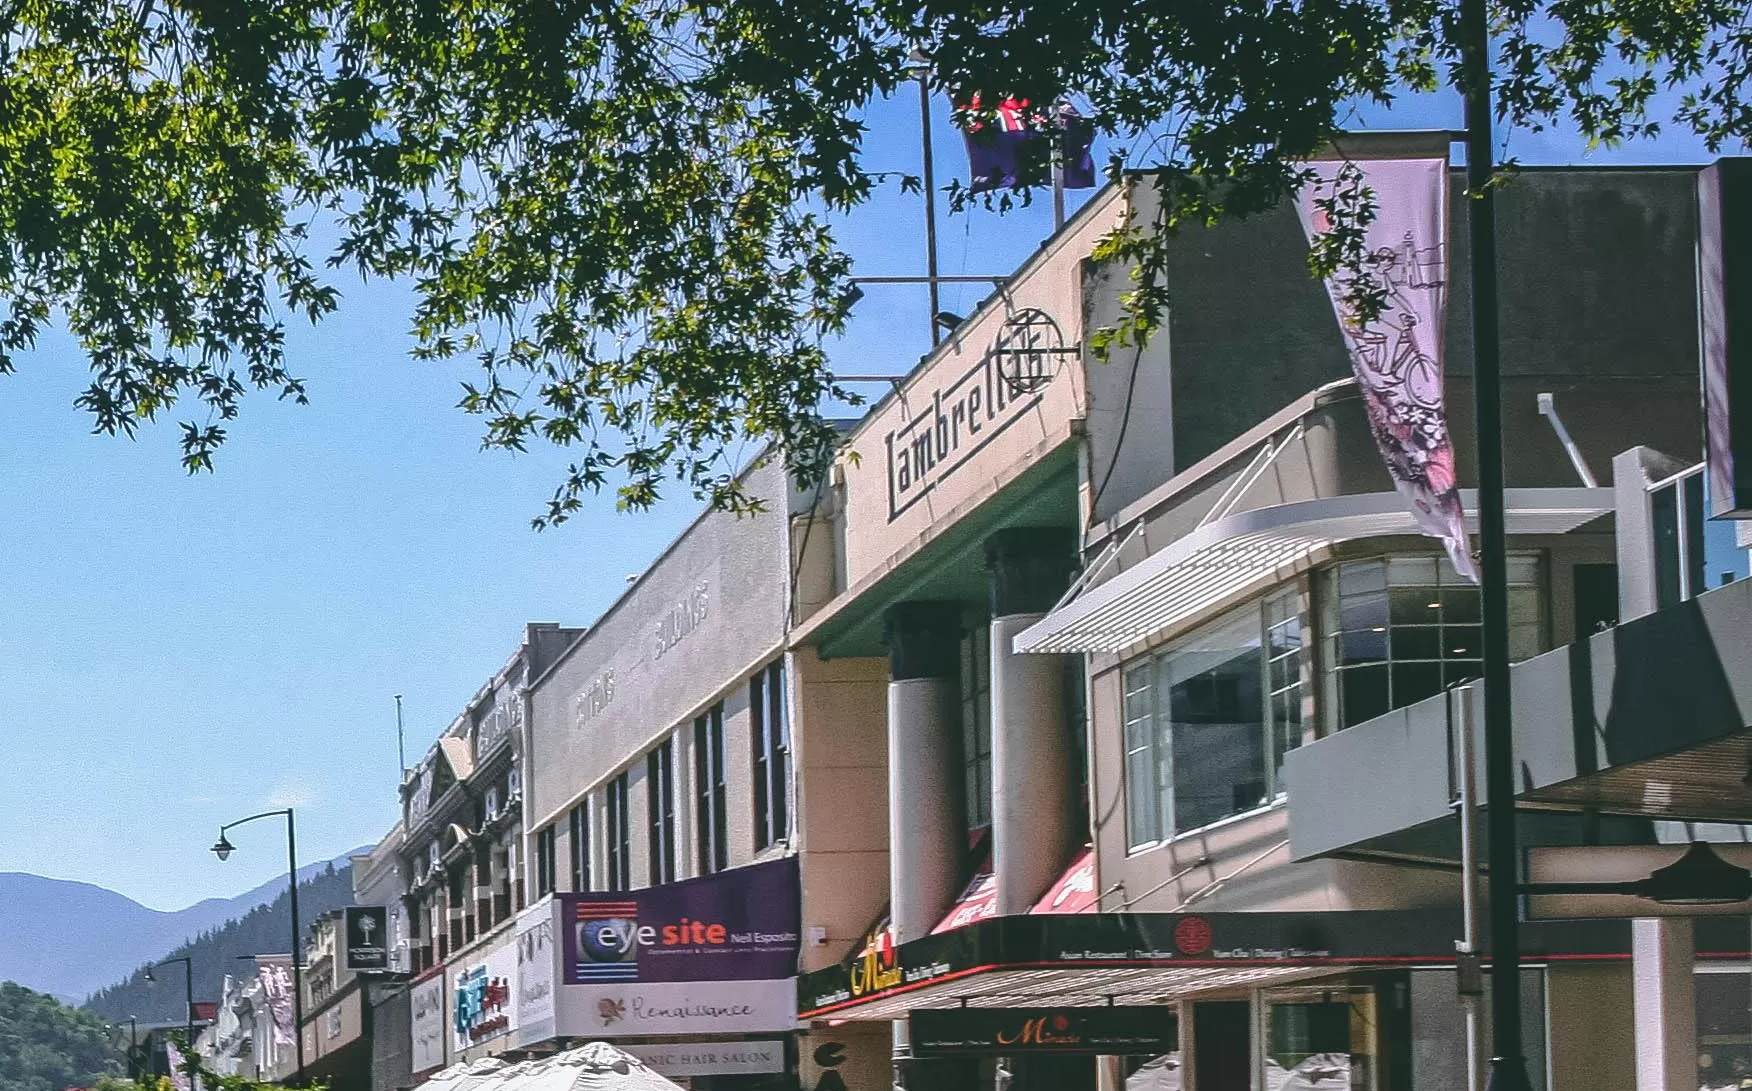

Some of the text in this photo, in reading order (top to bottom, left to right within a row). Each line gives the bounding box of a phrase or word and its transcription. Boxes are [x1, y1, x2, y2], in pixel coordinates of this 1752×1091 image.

[598, 925, 656, 953] eye
[662, 918, 727, 944] site
[731, 933, 752, 943] Neil
[632, 996, 754, 1020] Renaissance
[680, 1052, 718, 1065] HAIR
[722, 1051, 772, 1064] SALON
